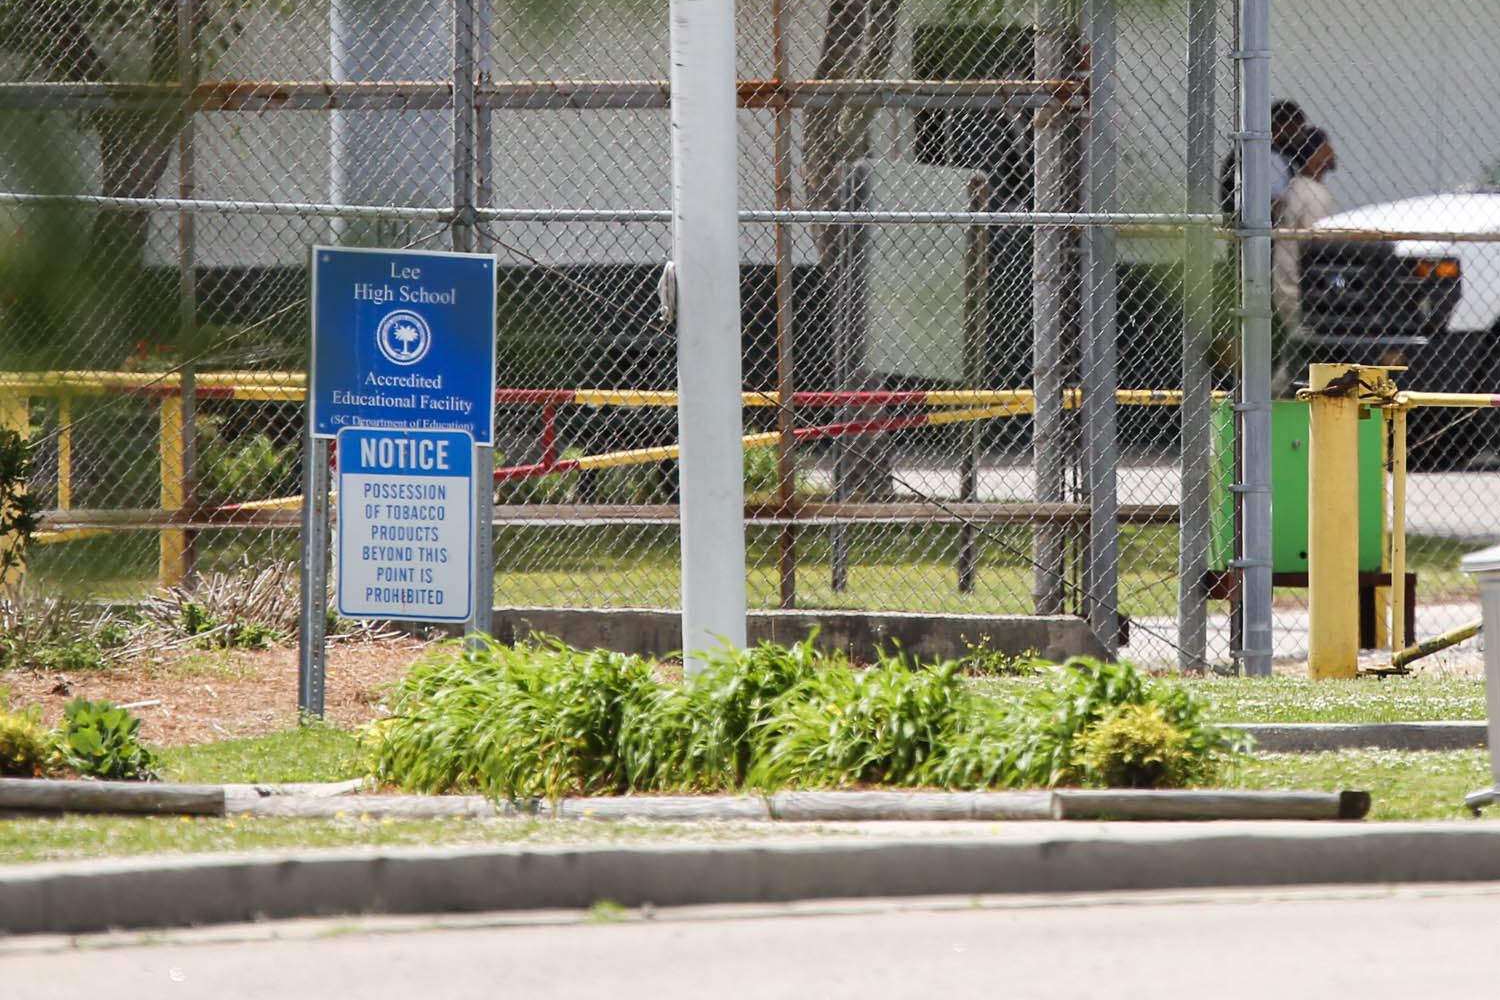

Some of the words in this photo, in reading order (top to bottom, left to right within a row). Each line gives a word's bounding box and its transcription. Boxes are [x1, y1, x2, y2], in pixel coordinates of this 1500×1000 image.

[390, 262, 421, 280] Lee
[354, 283, 393, 305] High
[399, 285, 456, 305] School
[364, 371, 442, 390] Accredited
[332, 390, 416, 409] Educational
[420, 395, 473, 415] Facility
[360, 437, 449, 470] NOTICE
[364, 483, 446, 500] POSSESSION
[365, 504, 380, 520] OF
[386, 504, 445, 521] TOBACCO
[371, 525, 439, 542] PRODUCTS
[362, 545, 413, 562] BEYOND
[418, 547, 448, 563] THIS
[376, 567, 415, 583] POINT
[420, 568, 433, 584] IS
[366, 588, 444, 605] PROHIBITED
